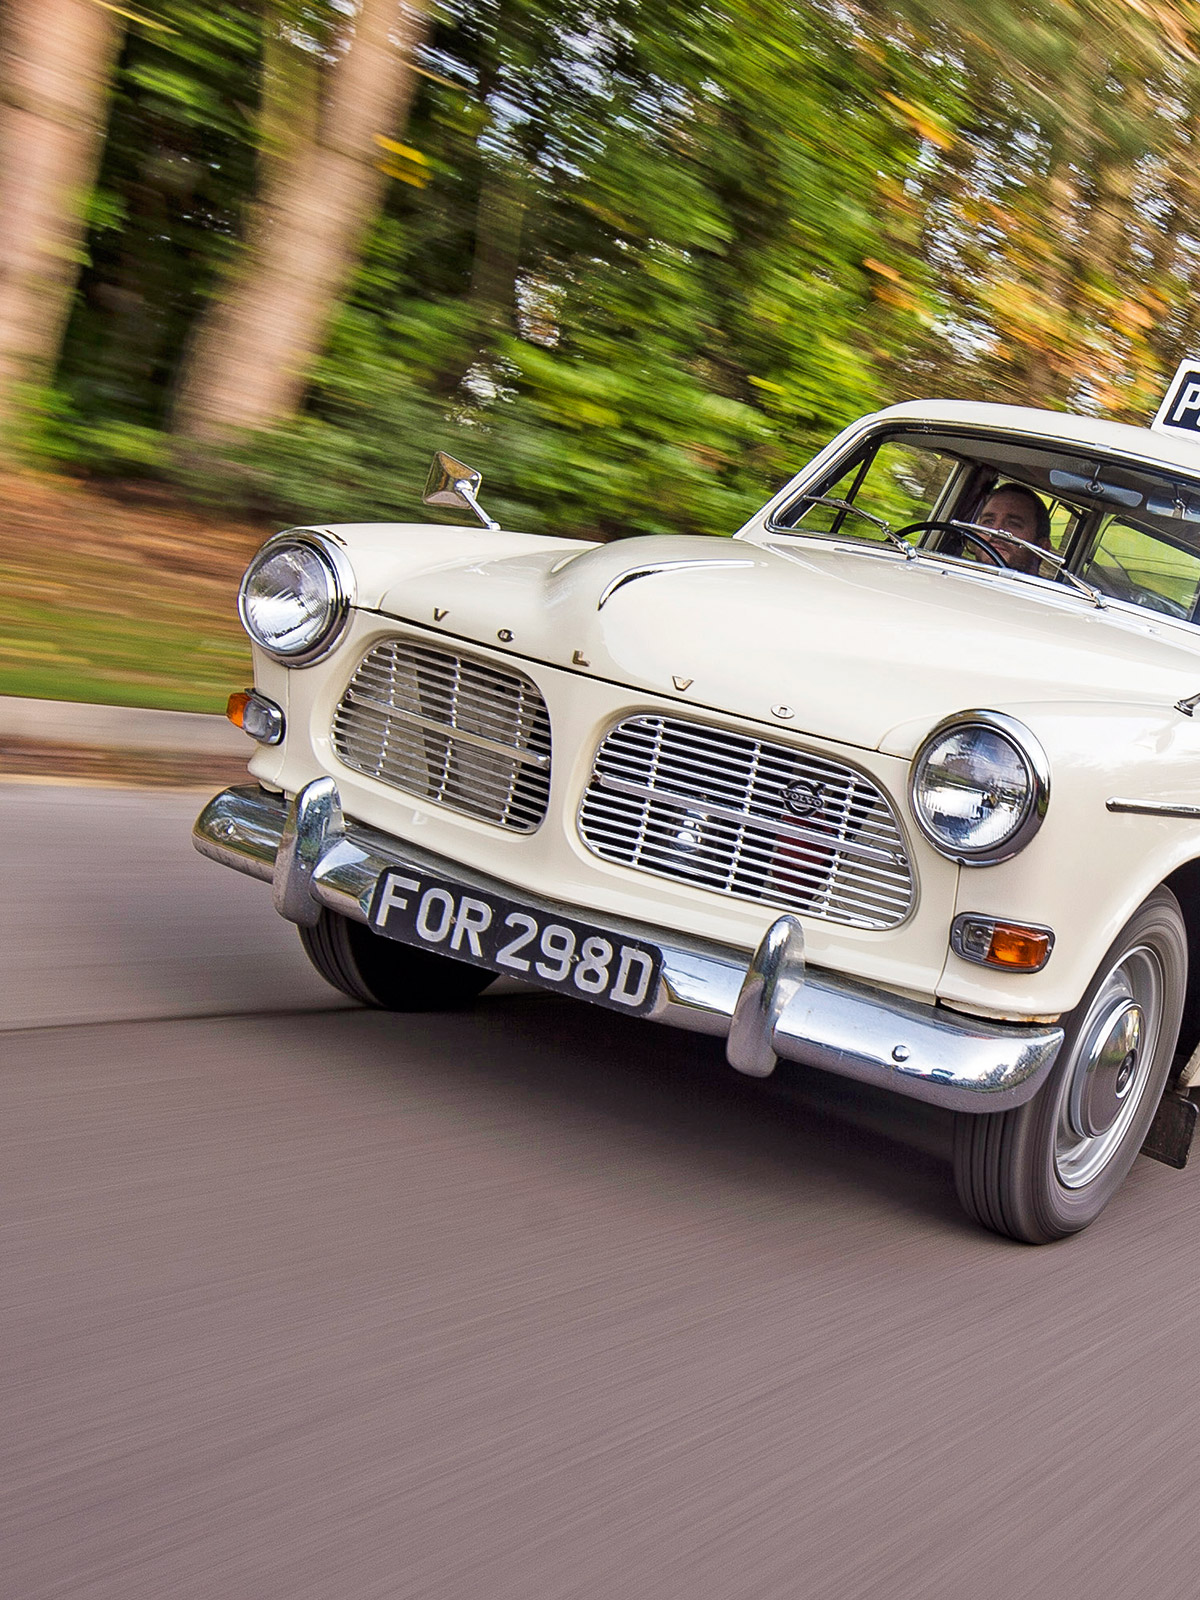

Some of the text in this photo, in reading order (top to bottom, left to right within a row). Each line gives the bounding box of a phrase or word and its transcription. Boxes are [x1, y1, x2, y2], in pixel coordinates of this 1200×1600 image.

[433, 607, 795, 719] VOLVO
[782, 790, 822, 806] VOLVO
[376, 873, 653, 1007] FOR 298D
